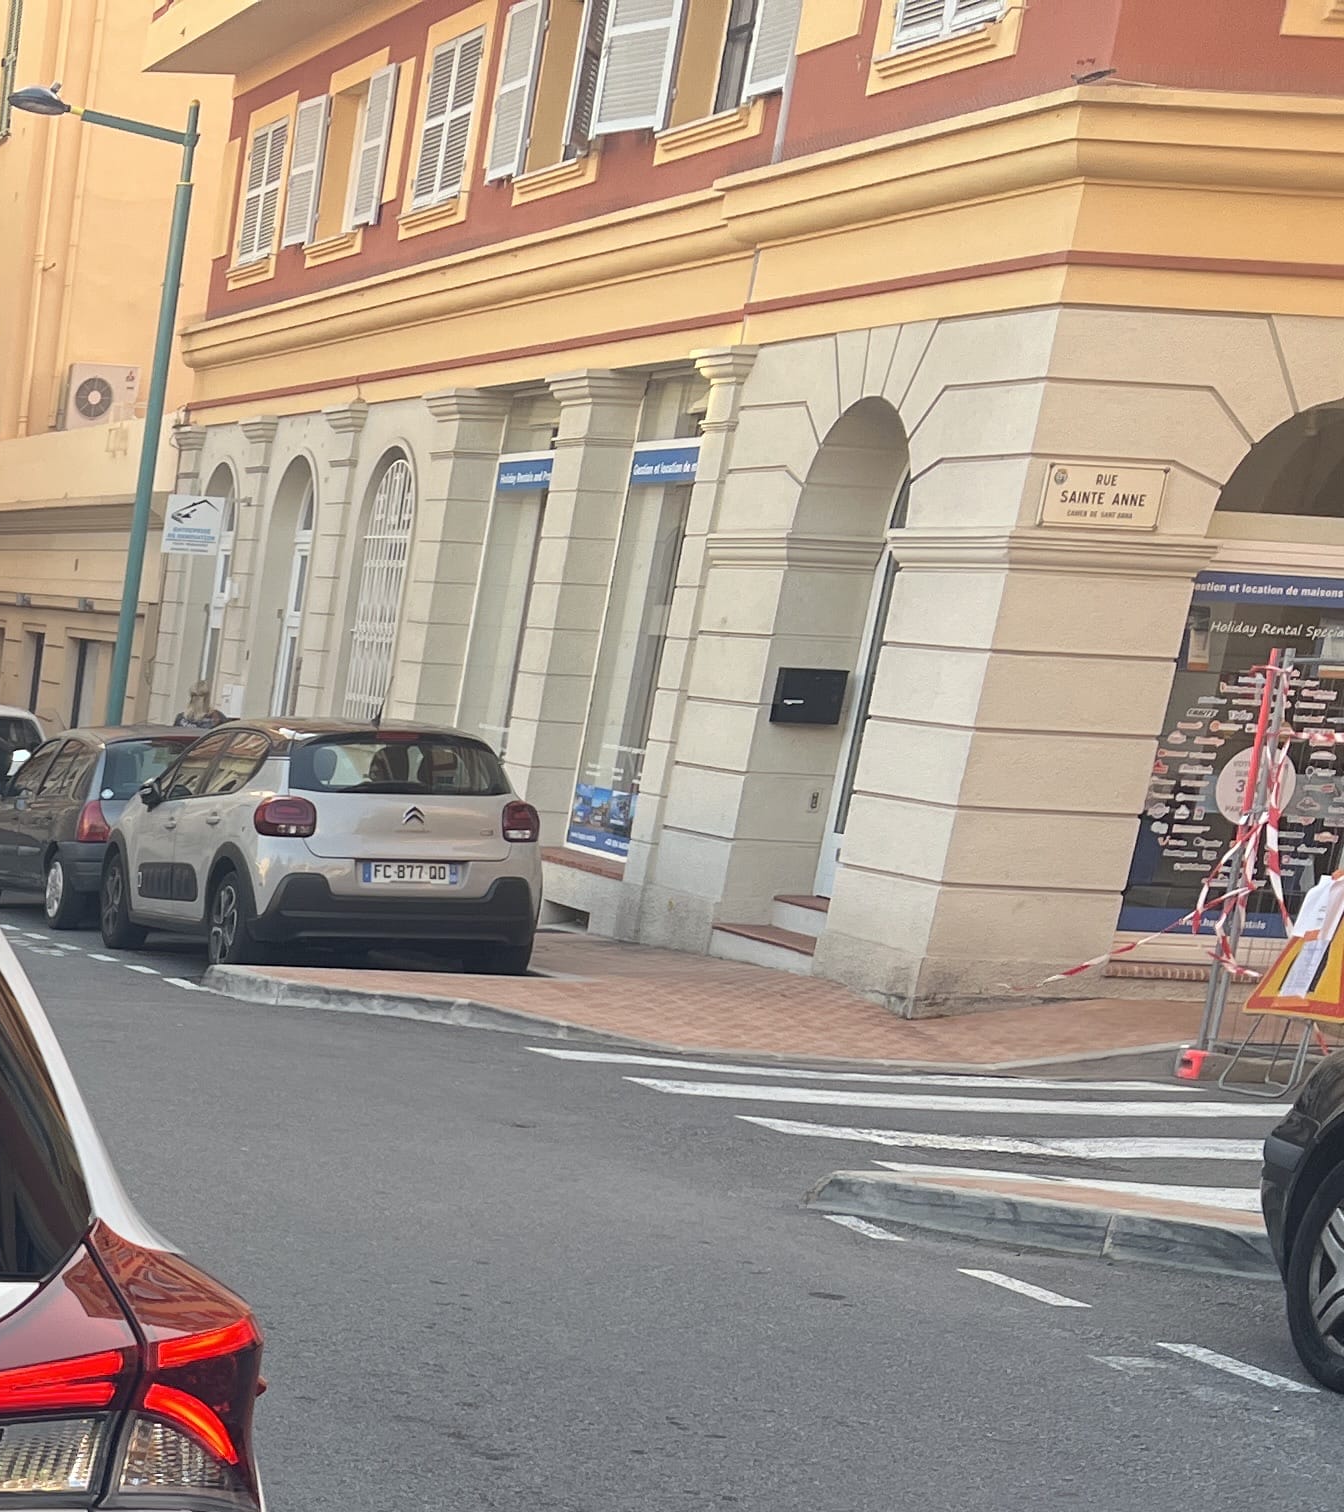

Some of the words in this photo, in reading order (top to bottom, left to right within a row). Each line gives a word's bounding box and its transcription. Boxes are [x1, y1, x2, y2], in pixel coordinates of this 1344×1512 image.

[1095, 474, 1119, 487] RUE
[1059, 490, 1106, 505] SAINTE
[1111, 492, 1147, 507] ANNE
[1195, 581, 1226, 592] estion
[1229, 583, 1239, 592] et
[1241, 583, 1286, 595] location
[1286, 585, 1299, 596] de
[1300, 586, 1344, 598] maisons
[1210, 620, 1257, 638] Holiday
[1261, 622, 1303, 637] Rental
